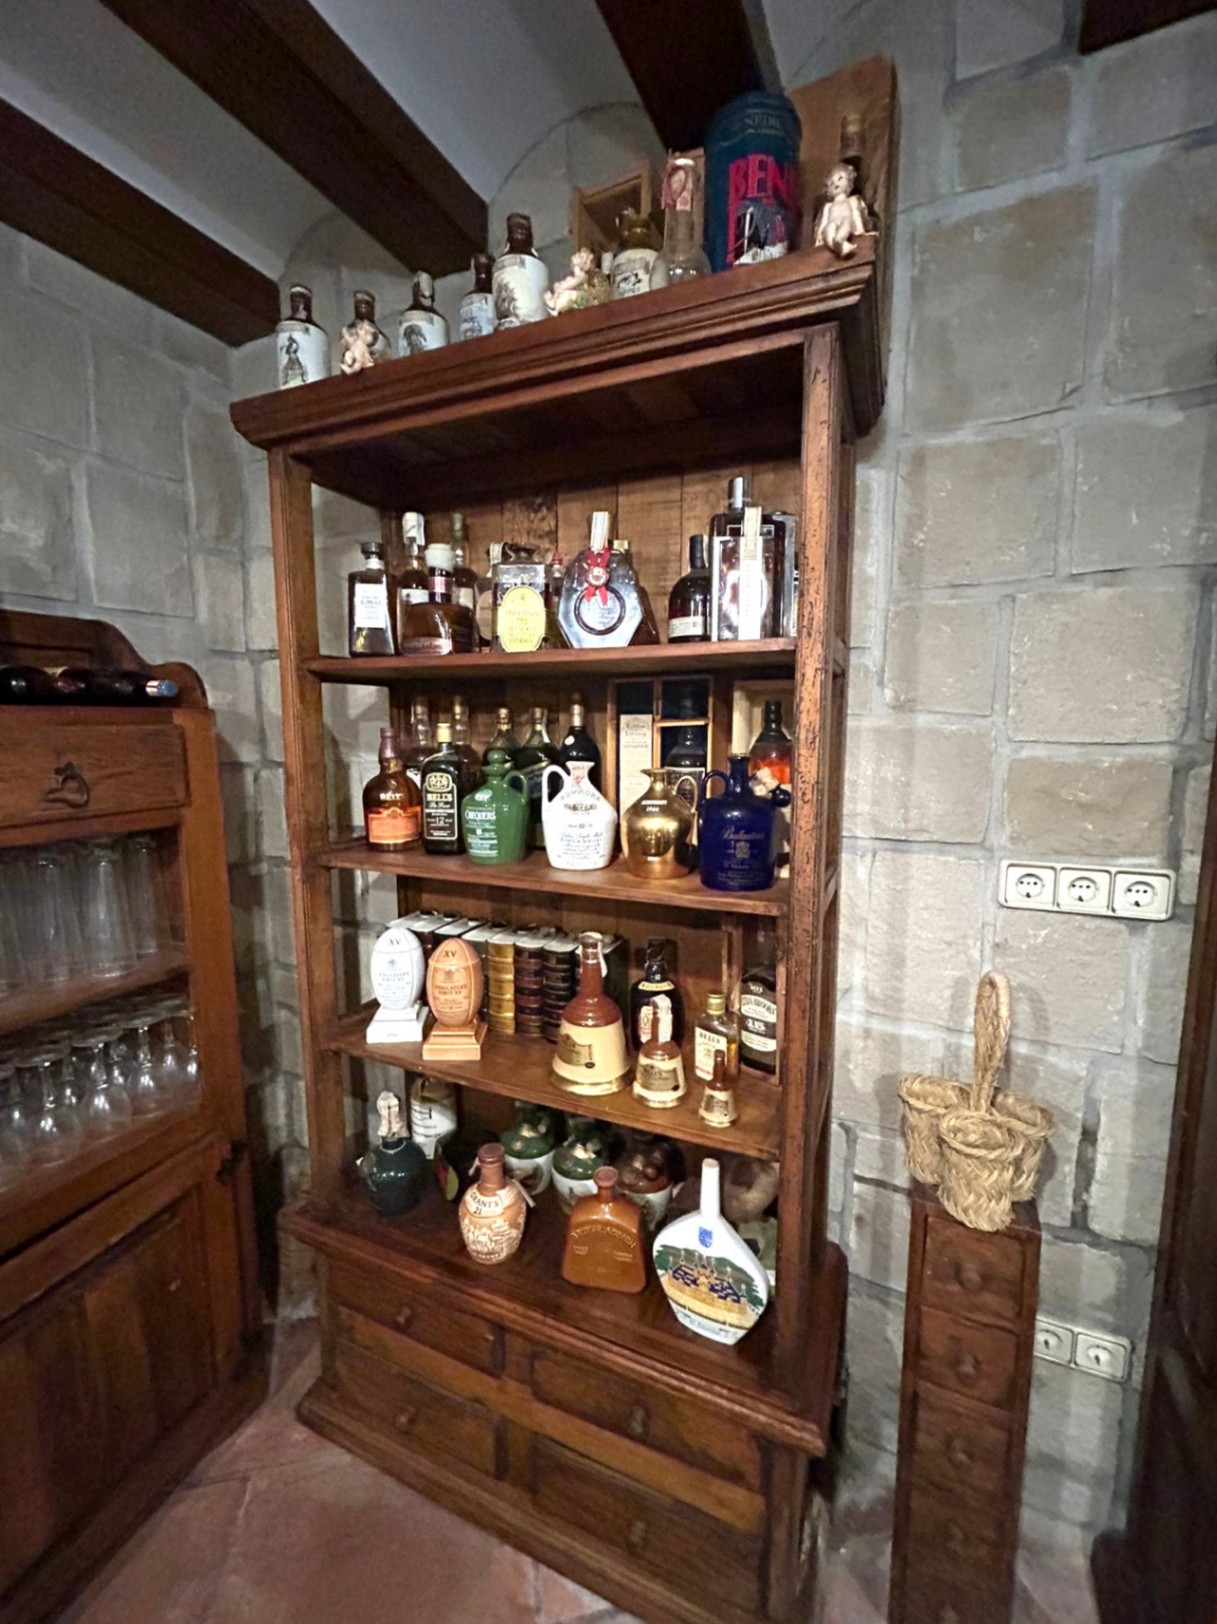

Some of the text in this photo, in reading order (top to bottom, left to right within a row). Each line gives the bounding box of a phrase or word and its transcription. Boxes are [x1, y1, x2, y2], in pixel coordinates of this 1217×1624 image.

[436, 817, 445, 825] 12
[389, 938, 401, 946] XV
[443, 950, 458, 958] XV
[746, 1018, 766, 1031] 15
[470, 1191, 500, 1209] GRANT'S
